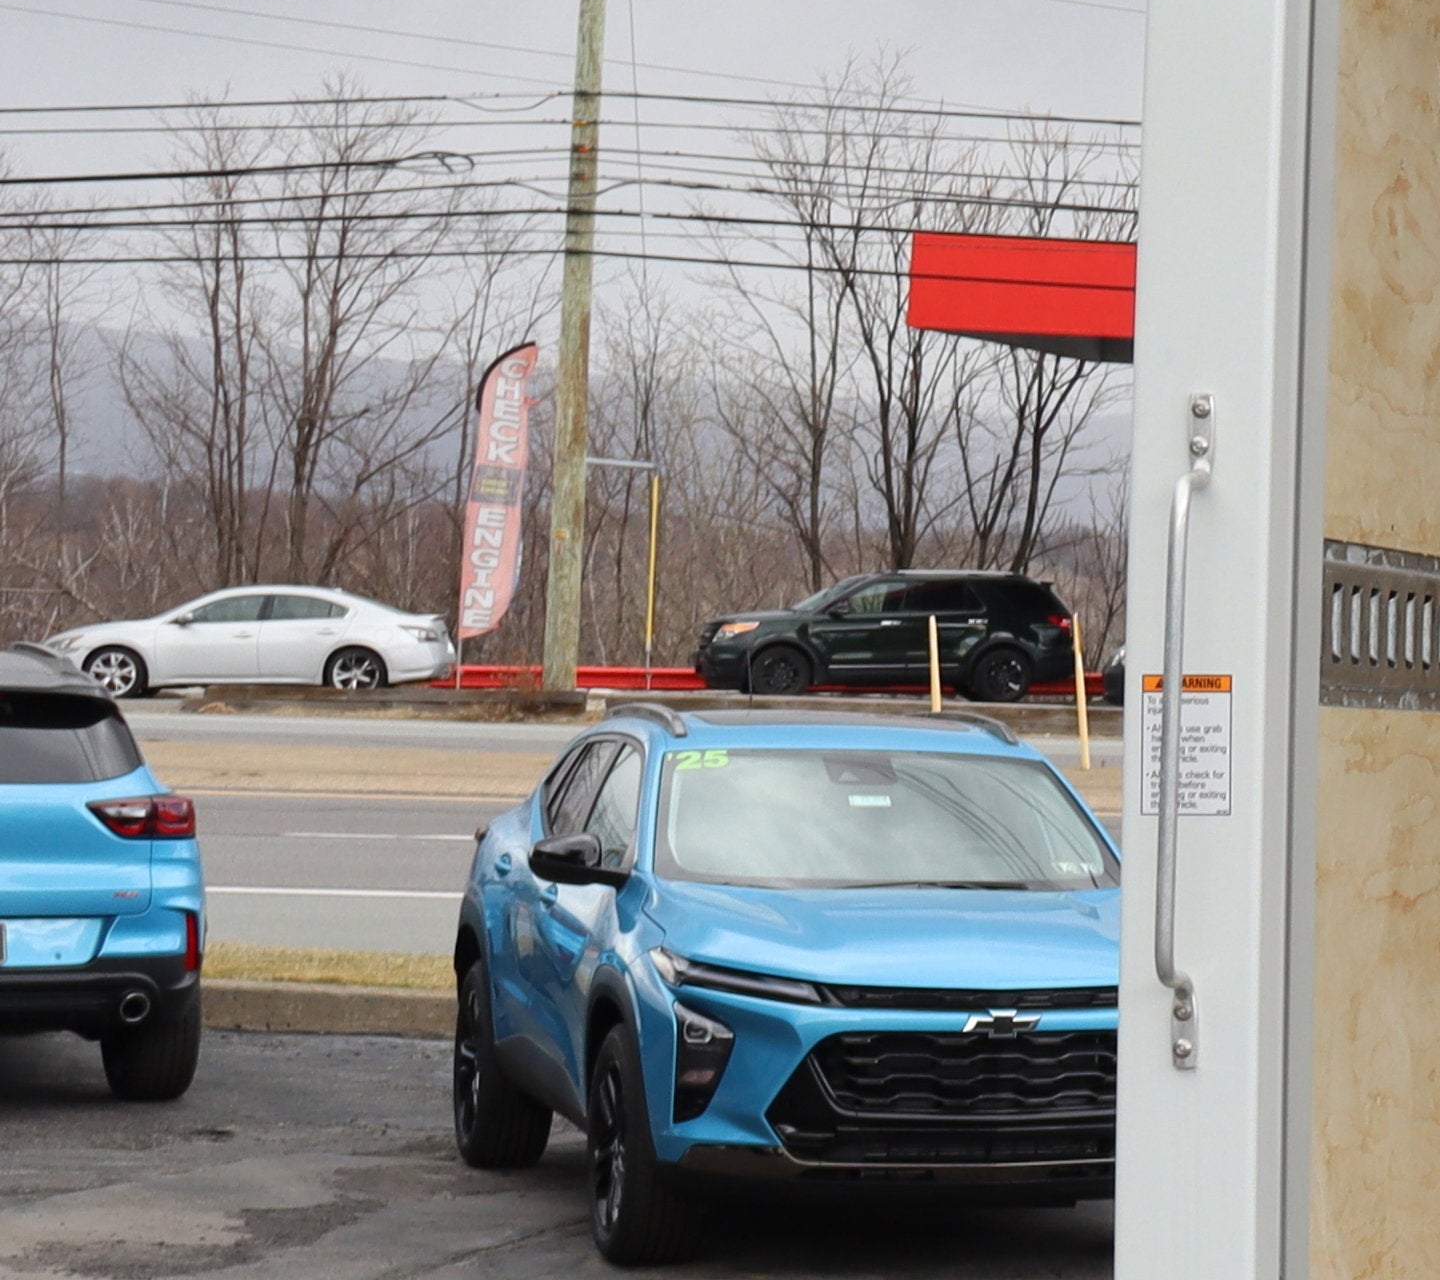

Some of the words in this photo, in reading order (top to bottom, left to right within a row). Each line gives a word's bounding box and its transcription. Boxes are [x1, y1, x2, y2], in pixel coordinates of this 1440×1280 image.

[486, 358, 529, 465] CHECK
[462, 506, 507, 629] ENGINE
[1181, 678, 1222, 689] ARNING
[1181, 734, 1206, 743] when
[1189, 745, 1198, 753] or
[1200, 744, 1228, 755] exiting
[1185, 770, 1211, 779] check
[1212, 770, 1225, 779] for
[1188, 791, 1197, 799] or
